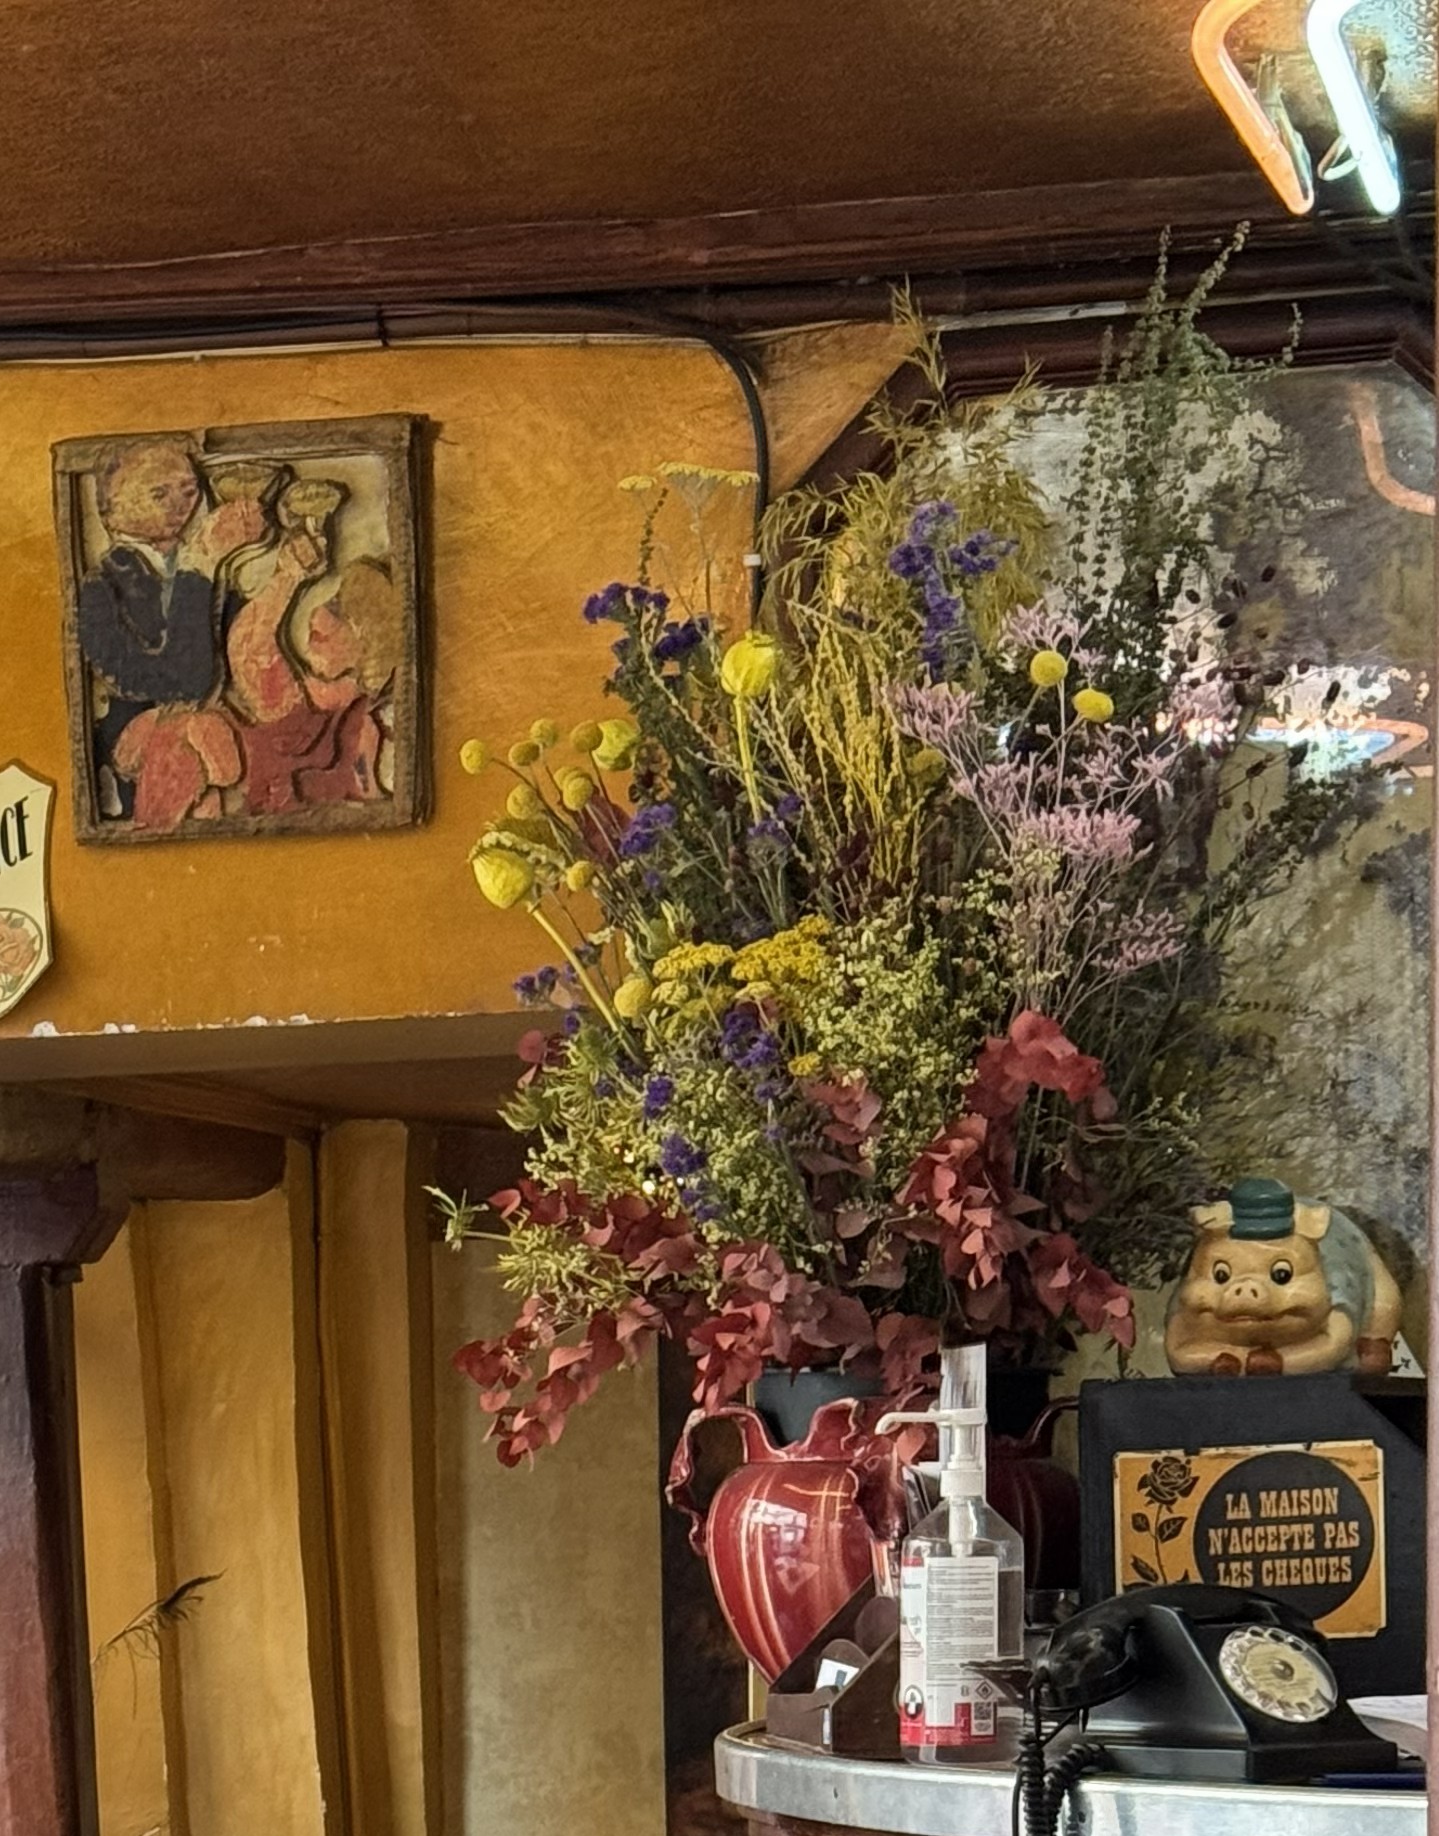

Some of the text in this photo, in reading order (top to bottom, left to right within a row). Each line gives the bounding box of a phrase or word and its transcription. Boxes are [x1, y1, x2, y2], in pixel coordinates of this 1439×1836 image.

[1224, 1487, 1340, 1520] LA MAISON
[1208, 1520, 1361, 1555] N'ACCEPTE PAS
[1216, 1555, 1353, 1588] LES CHEQUES
